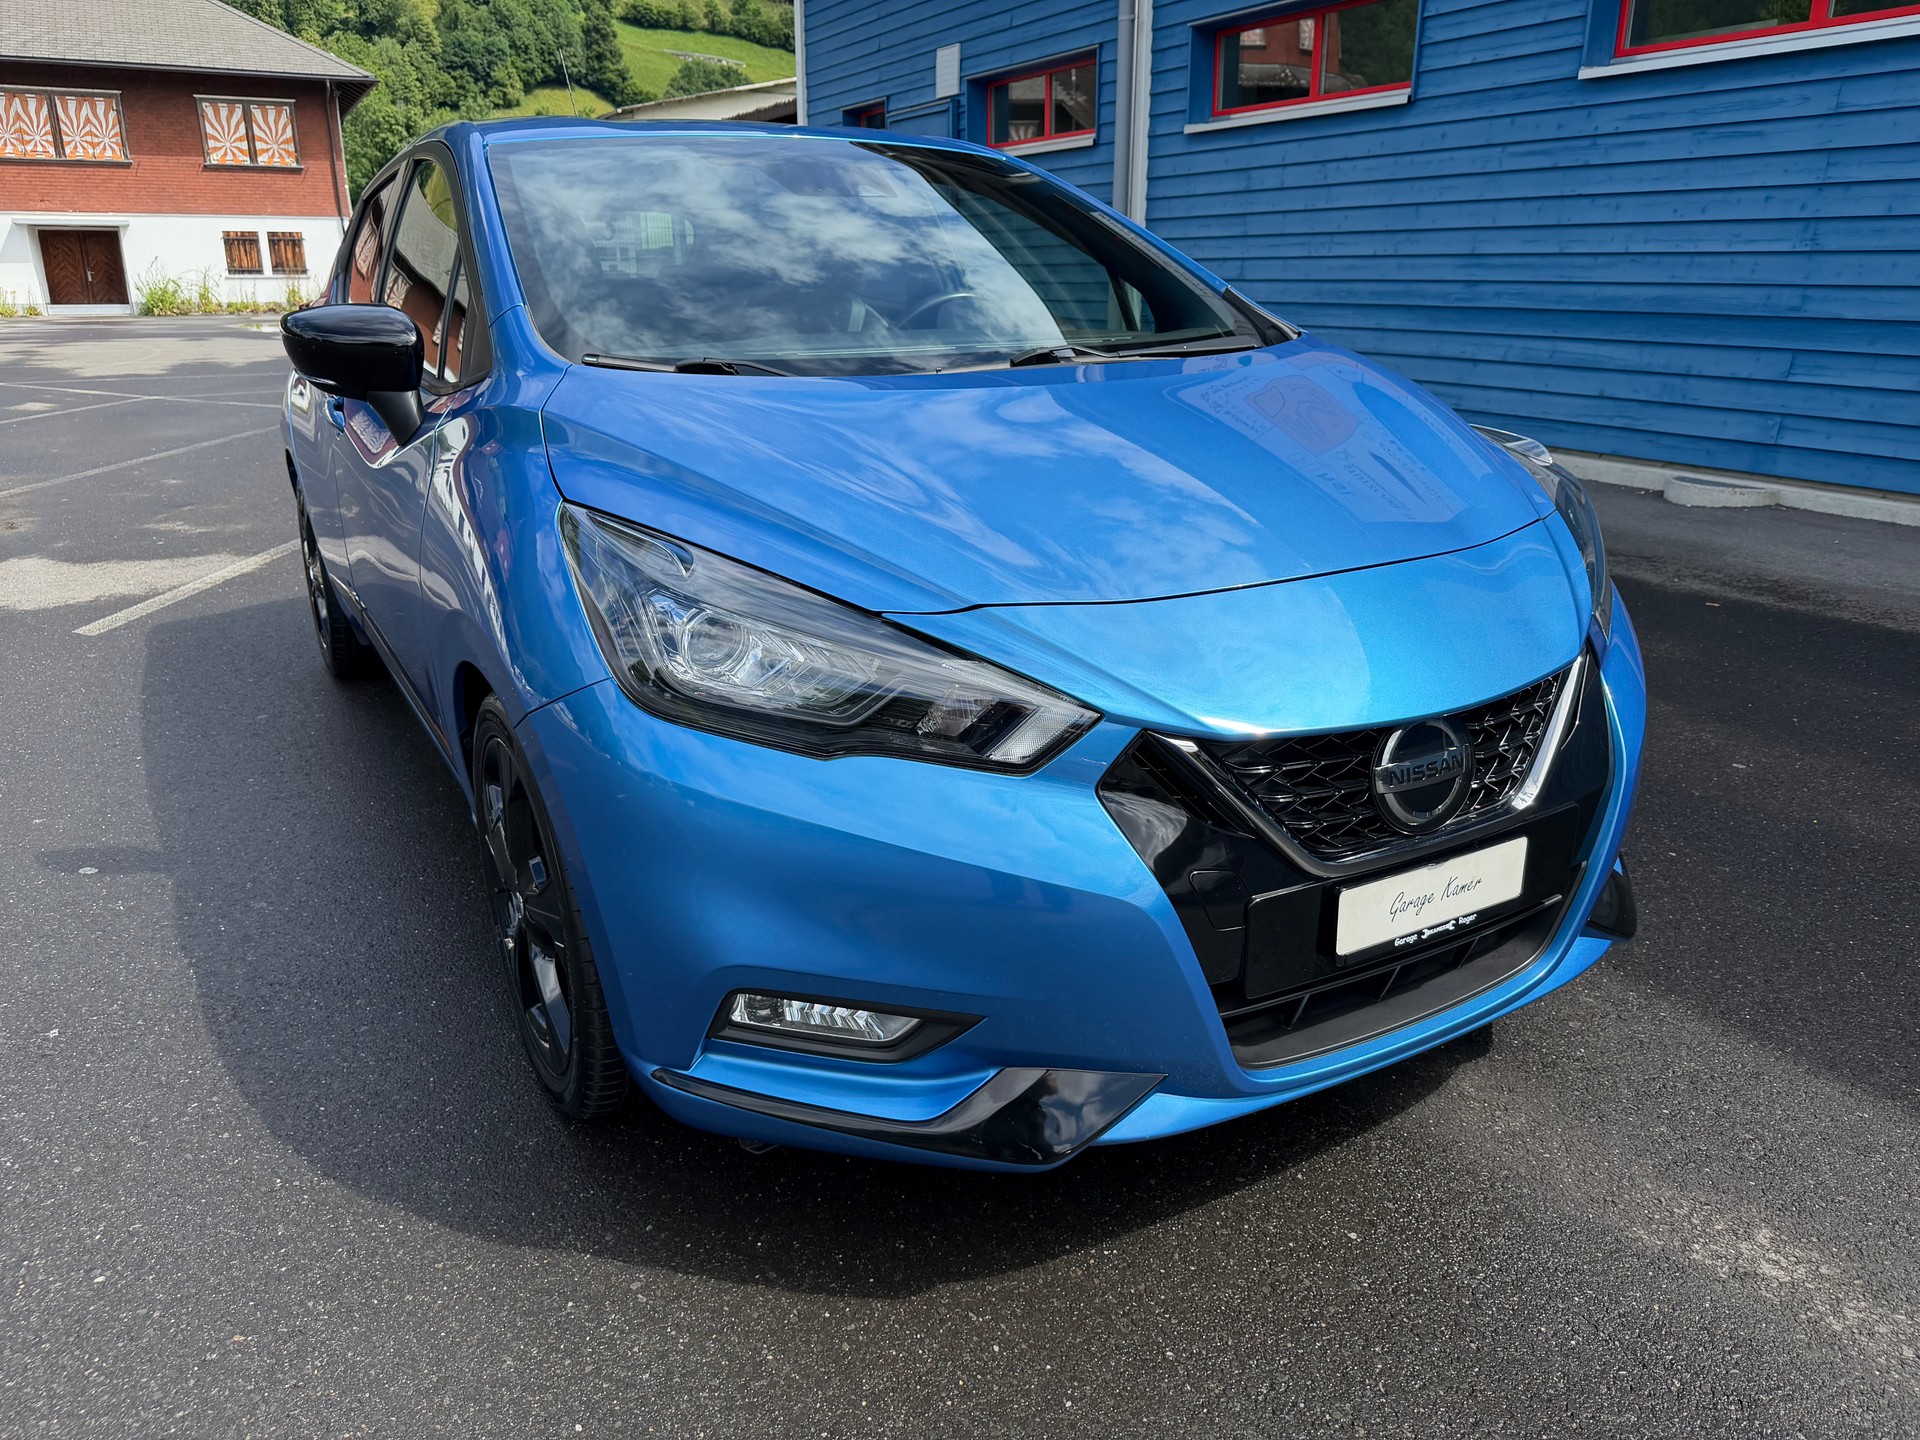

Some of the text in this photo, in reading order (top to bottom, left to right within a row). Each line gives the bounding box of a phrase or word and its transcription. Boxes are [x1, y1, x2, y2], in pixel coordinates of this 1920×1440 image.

[1389, 752, 1464, 787] NISSAN
[1390, 876, 1482, 923] Garage Kamer
[1394, 934, 1418, 947] Garage
[1458, 914, 1477, 925] Roger
